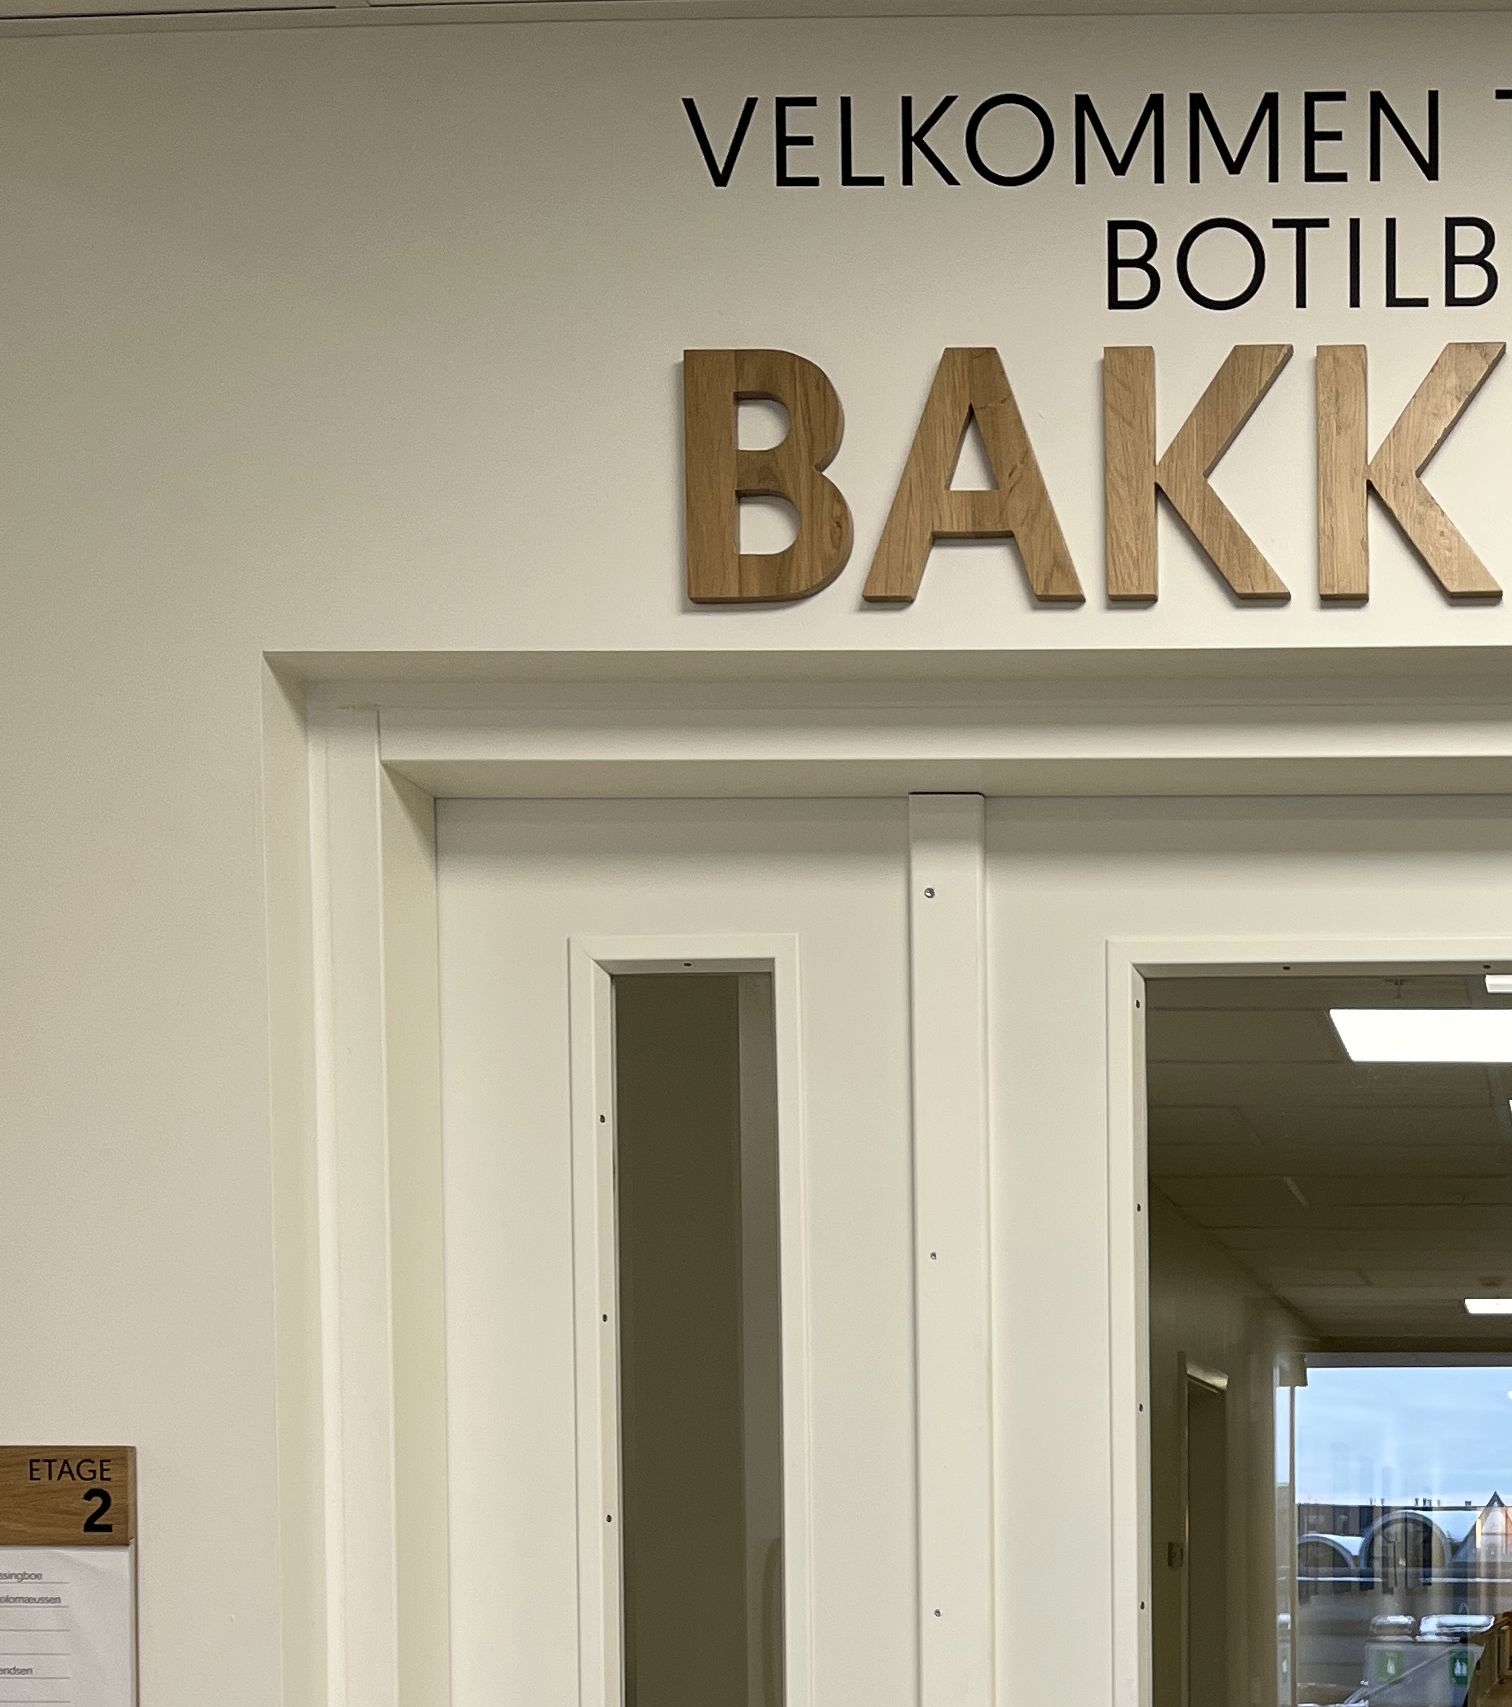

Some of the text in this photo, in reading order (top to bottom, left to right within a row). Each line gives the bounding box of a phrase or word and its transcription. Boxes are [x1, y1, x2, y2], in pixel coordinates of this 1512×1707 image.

[682, 89, 1439, 188] VELKOMMEN
[29, 1458, 112, 1482] ETAGE
[83, 1487, 113, 1533] 2
